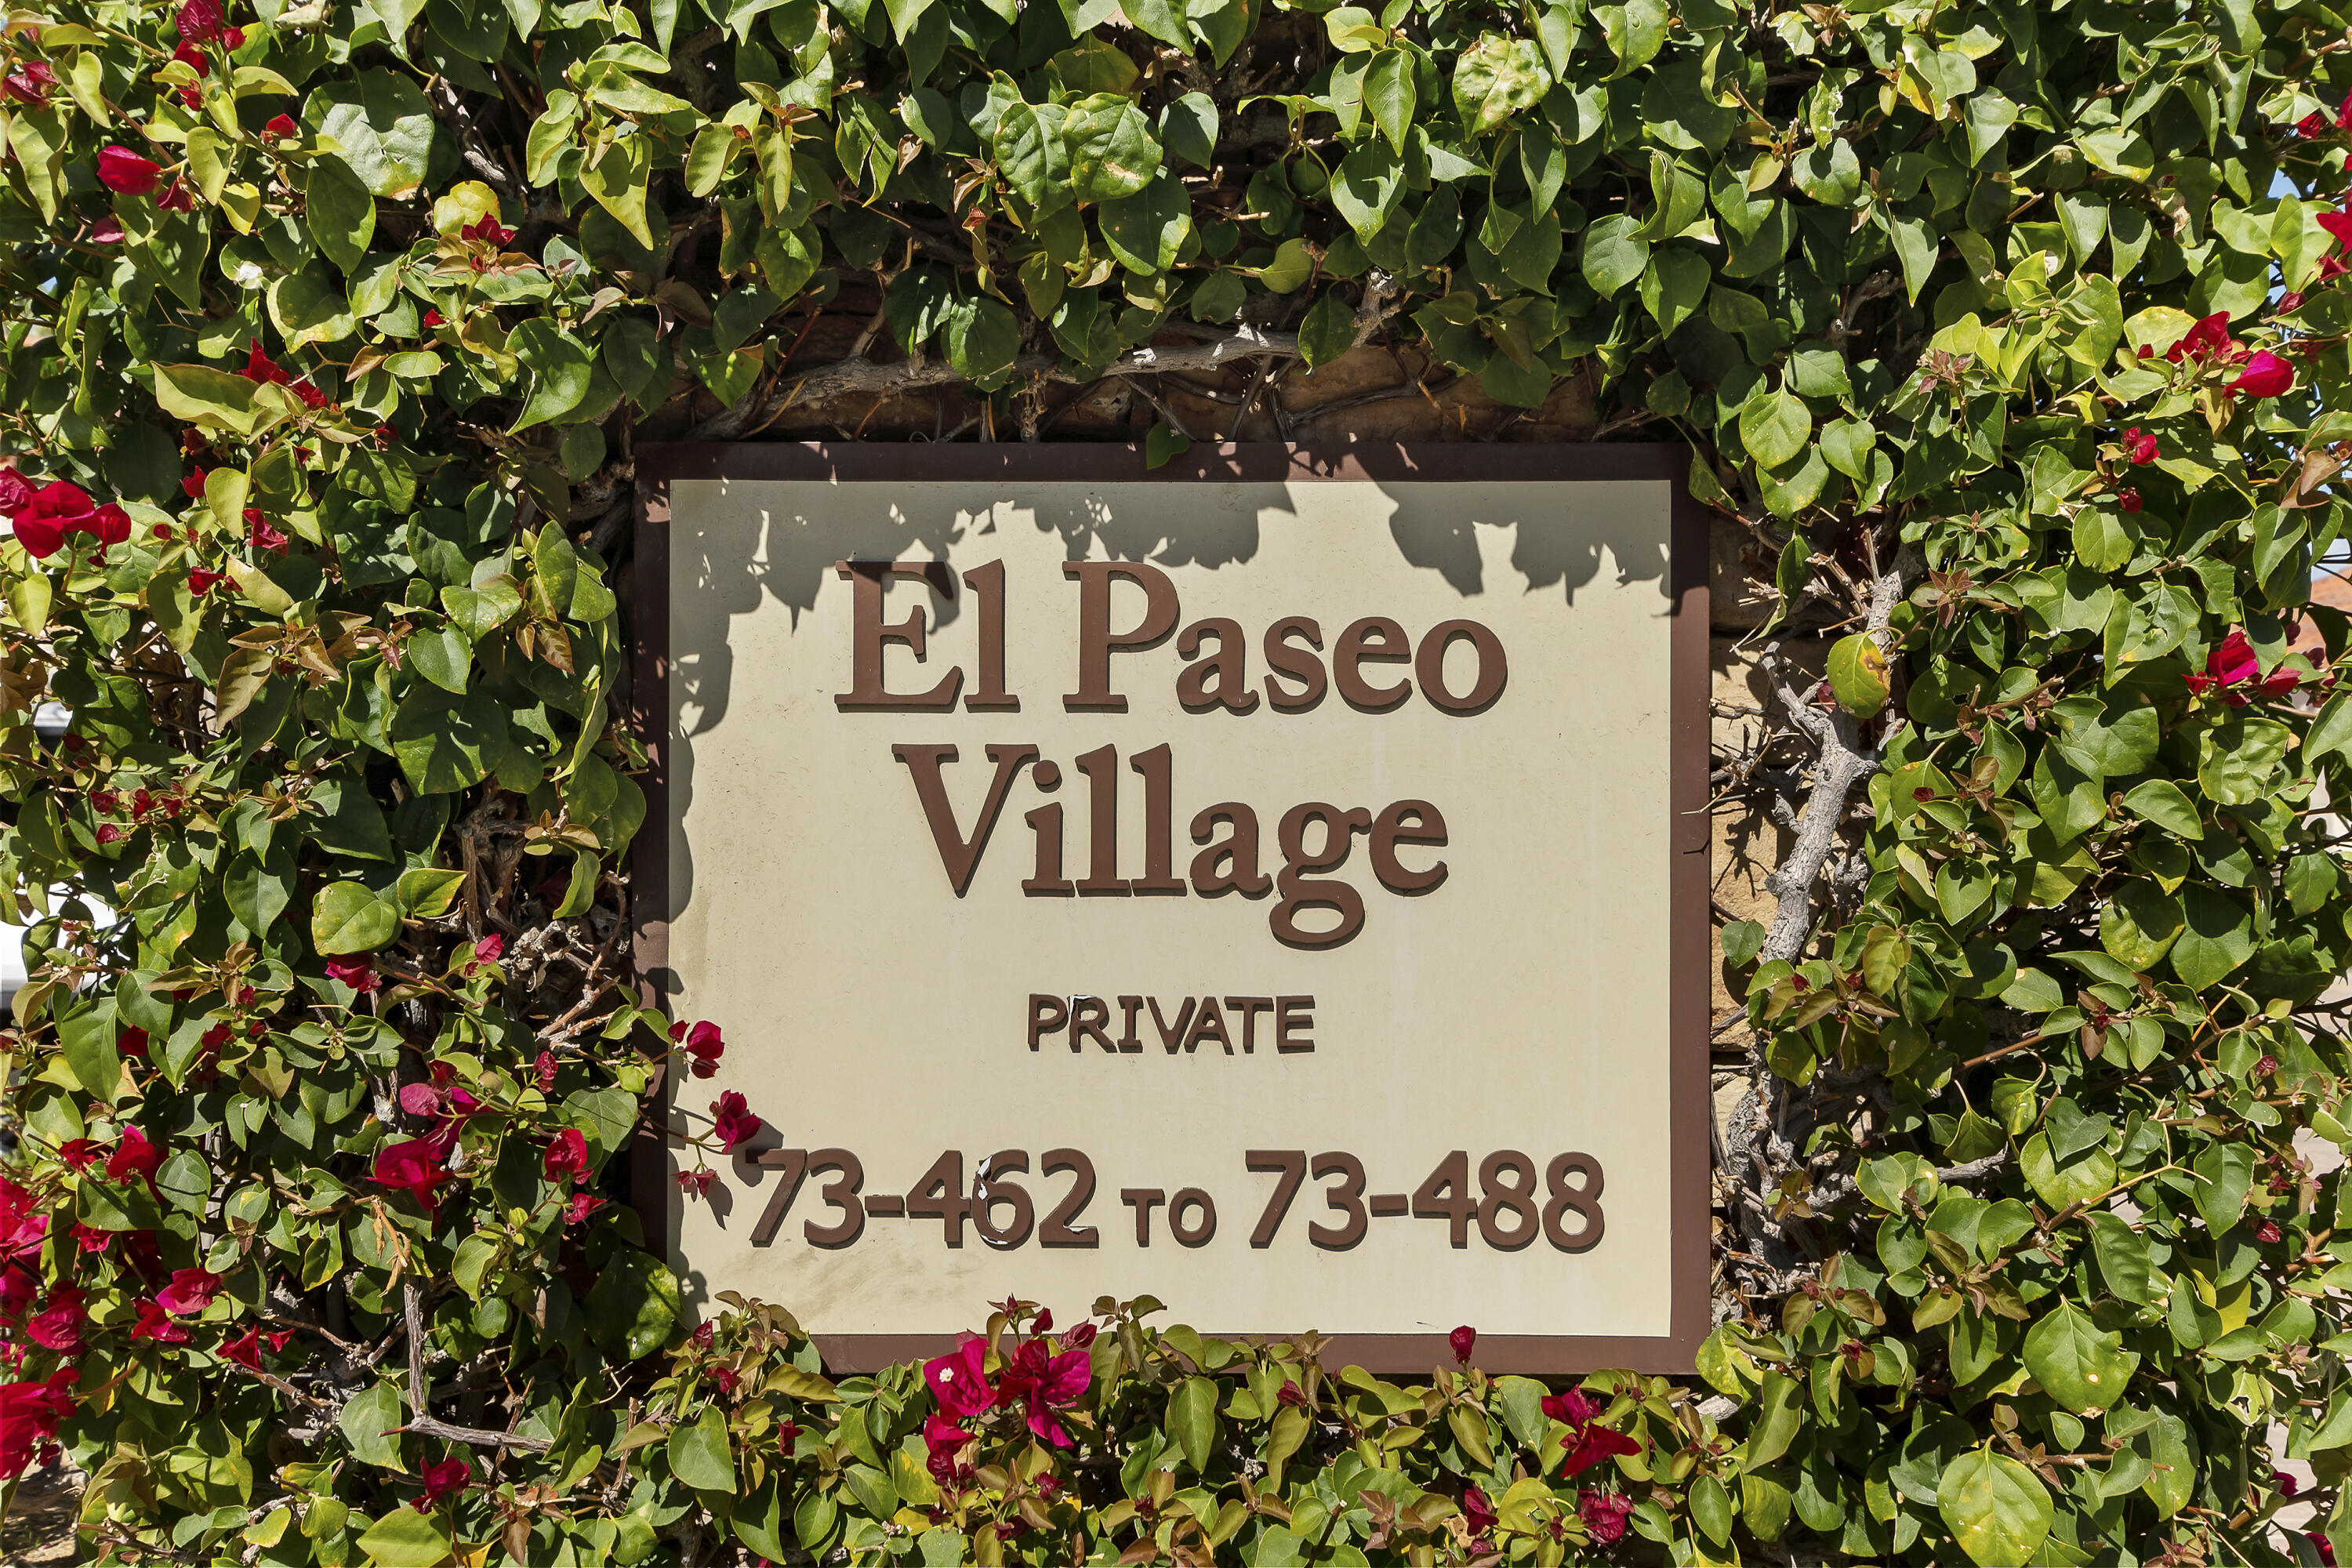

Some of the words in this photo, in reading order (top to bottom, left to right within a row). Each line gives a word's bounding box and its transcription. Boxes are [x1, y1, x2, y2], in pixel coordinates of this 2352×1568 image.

[834, 558, 1020, 713] El
[1062, 560, 1508, 716] Paseo
[891, 742, 1448, 950] Village
[1029, 993, 1316, 1054] PRIVATE
[745, 1148, 1098, 1250] 73-462
[1121, 1188, 1218, 1248] TO
[1245, 1149, 1605, 1253] 73-488
